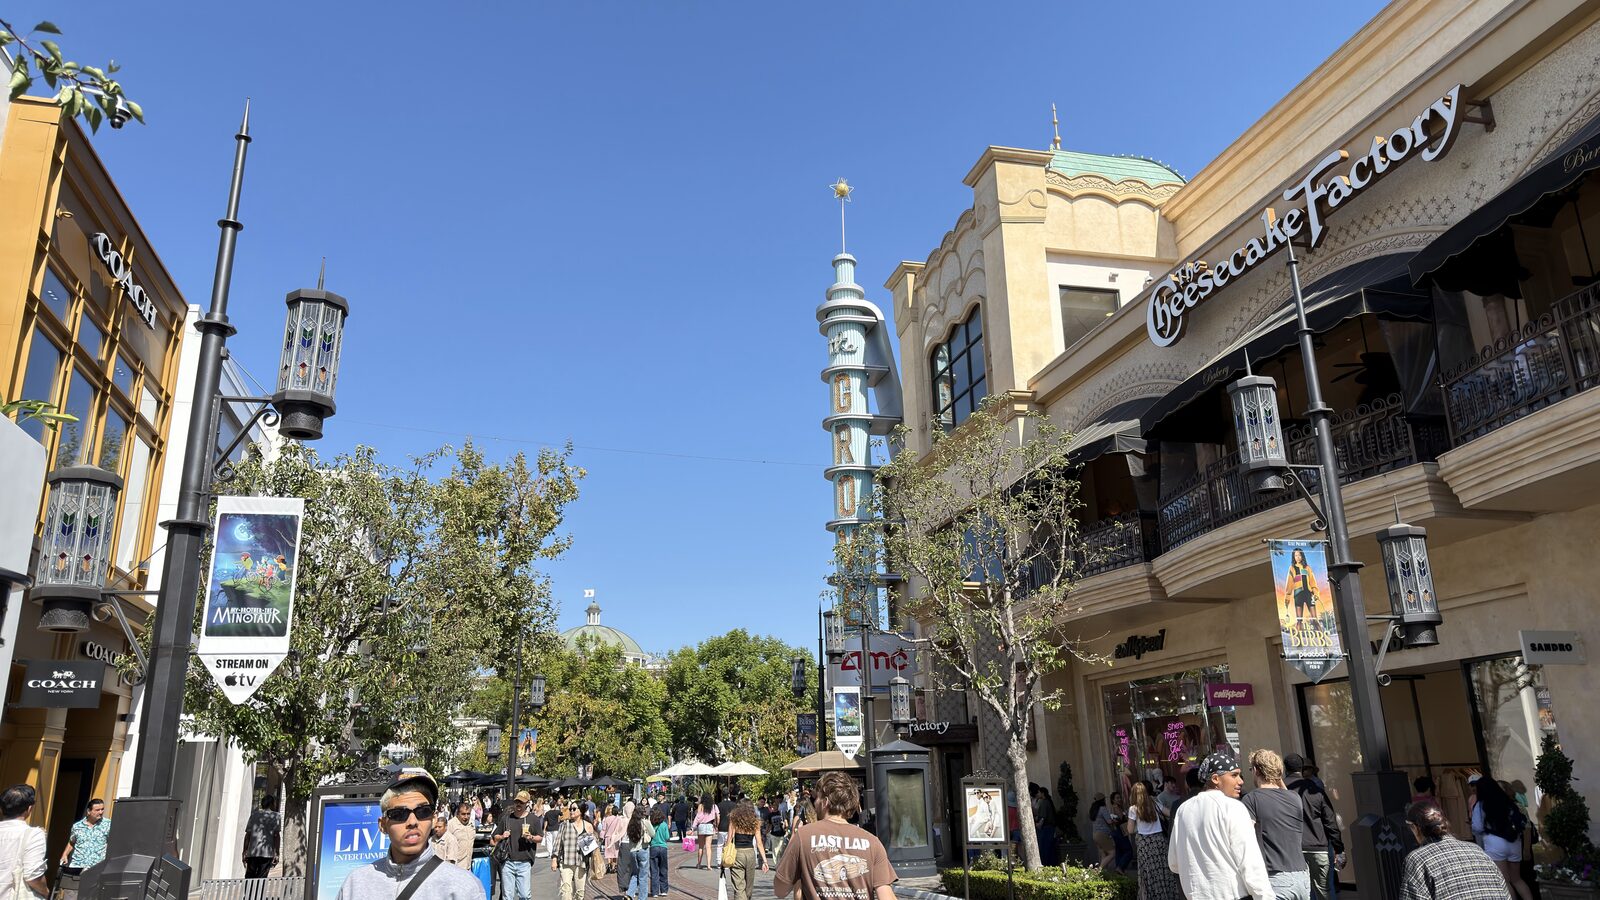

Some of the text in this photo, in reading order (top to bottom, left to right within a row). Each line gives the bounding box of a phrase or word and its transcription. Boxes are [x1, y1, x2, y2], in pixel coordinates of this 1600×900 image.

[1146, 83, 1464, 348] The Cheesecake Factory
[94, 232, 158, 330] COACH
[212, 607, 282, 624] MINOTAUR
[86, 641, 119, 666] COAC
[1529, 642, 1573, 652] SANDRO
[215, 659, 269, 669] STREAM ON
[841, 650, 908, 671] amc
[27, 680, 97, 689] COACH
[239, 673, 256, 687] tv
[810, 835, 843, 849] LAST
[844, 837, 870, 851] LAP
